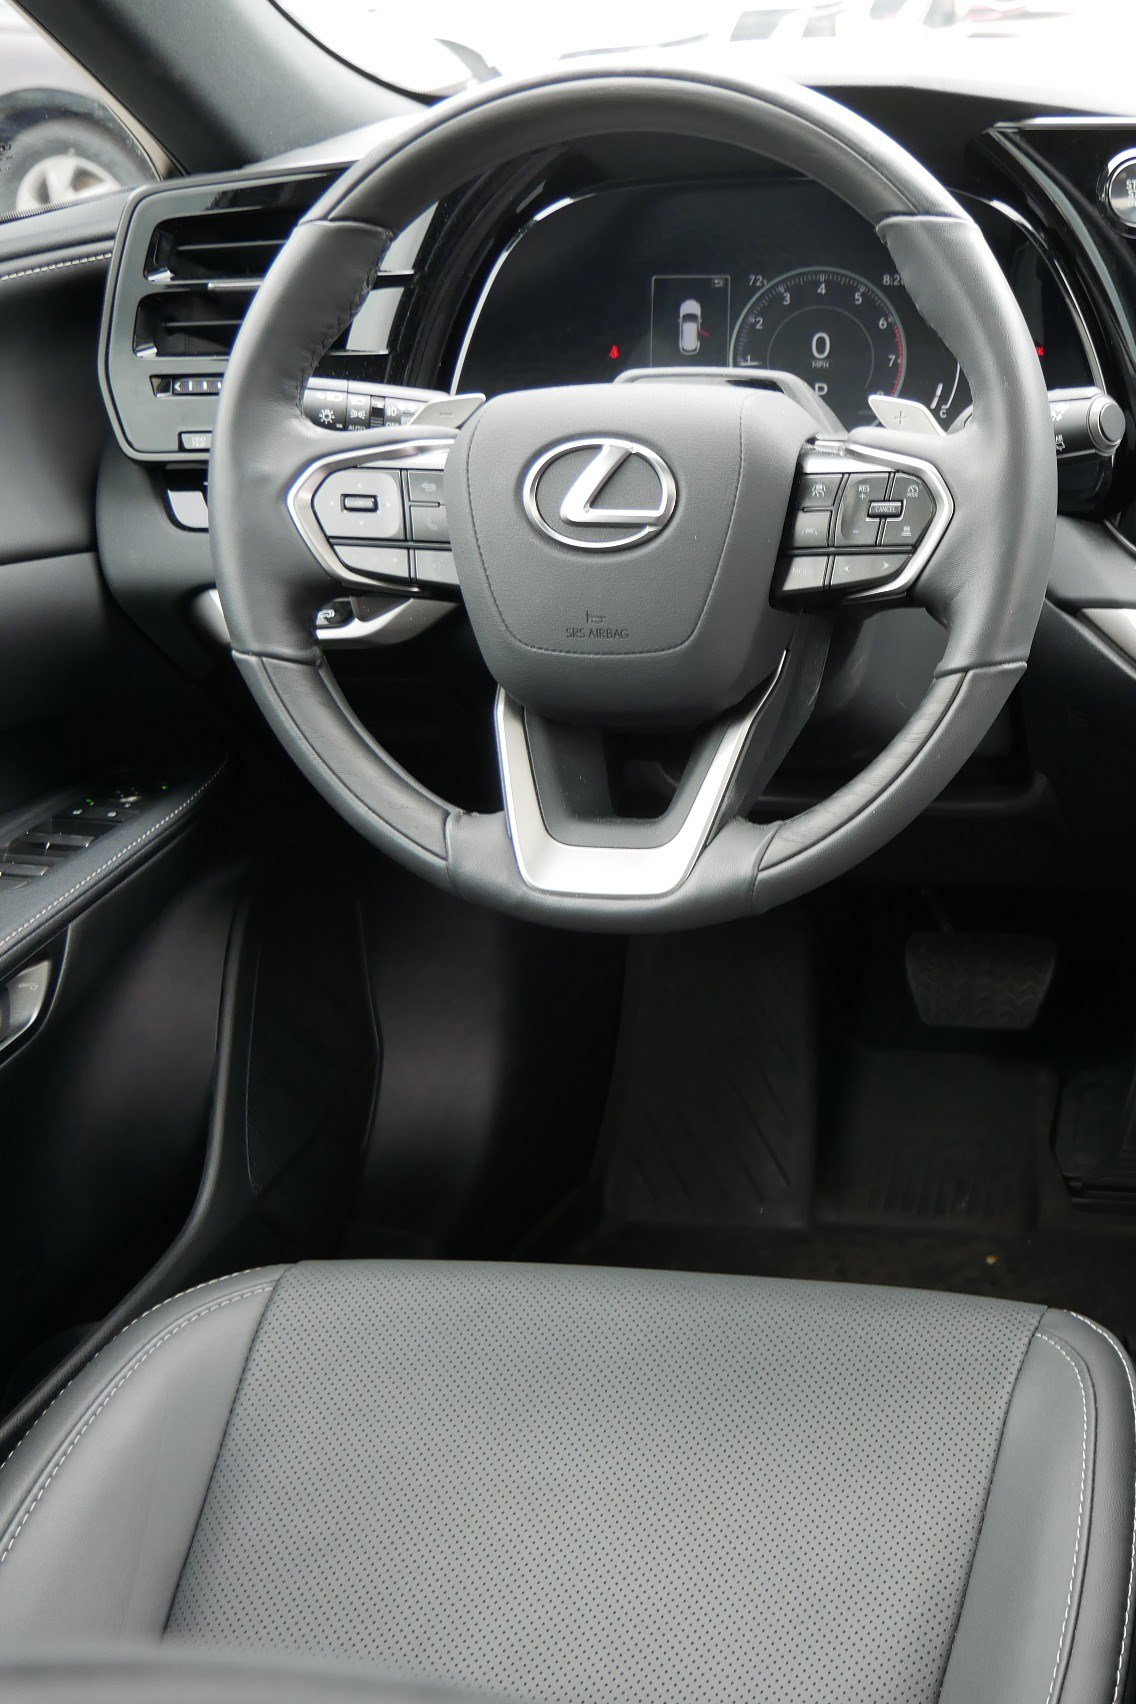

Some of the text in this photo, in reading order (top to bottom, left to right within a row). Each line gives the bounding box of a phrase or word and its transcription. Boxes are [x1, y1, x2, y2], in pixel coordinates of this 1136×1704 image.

[817, 283, 826, 295] 4
[782, 292, 791, 305] 3
[854, 291, 863, 305] 5
[755, 316, 763, 330] 2
[878, 316, 887, 330] 6
[811, 331, 831, 359] 0
[812, 361, 829, 369] MPH
[888, 354, 896, 367] 7
[858, 484, 870, 493] RES
[565, 627, 629, 640] SRS AIRBAG
